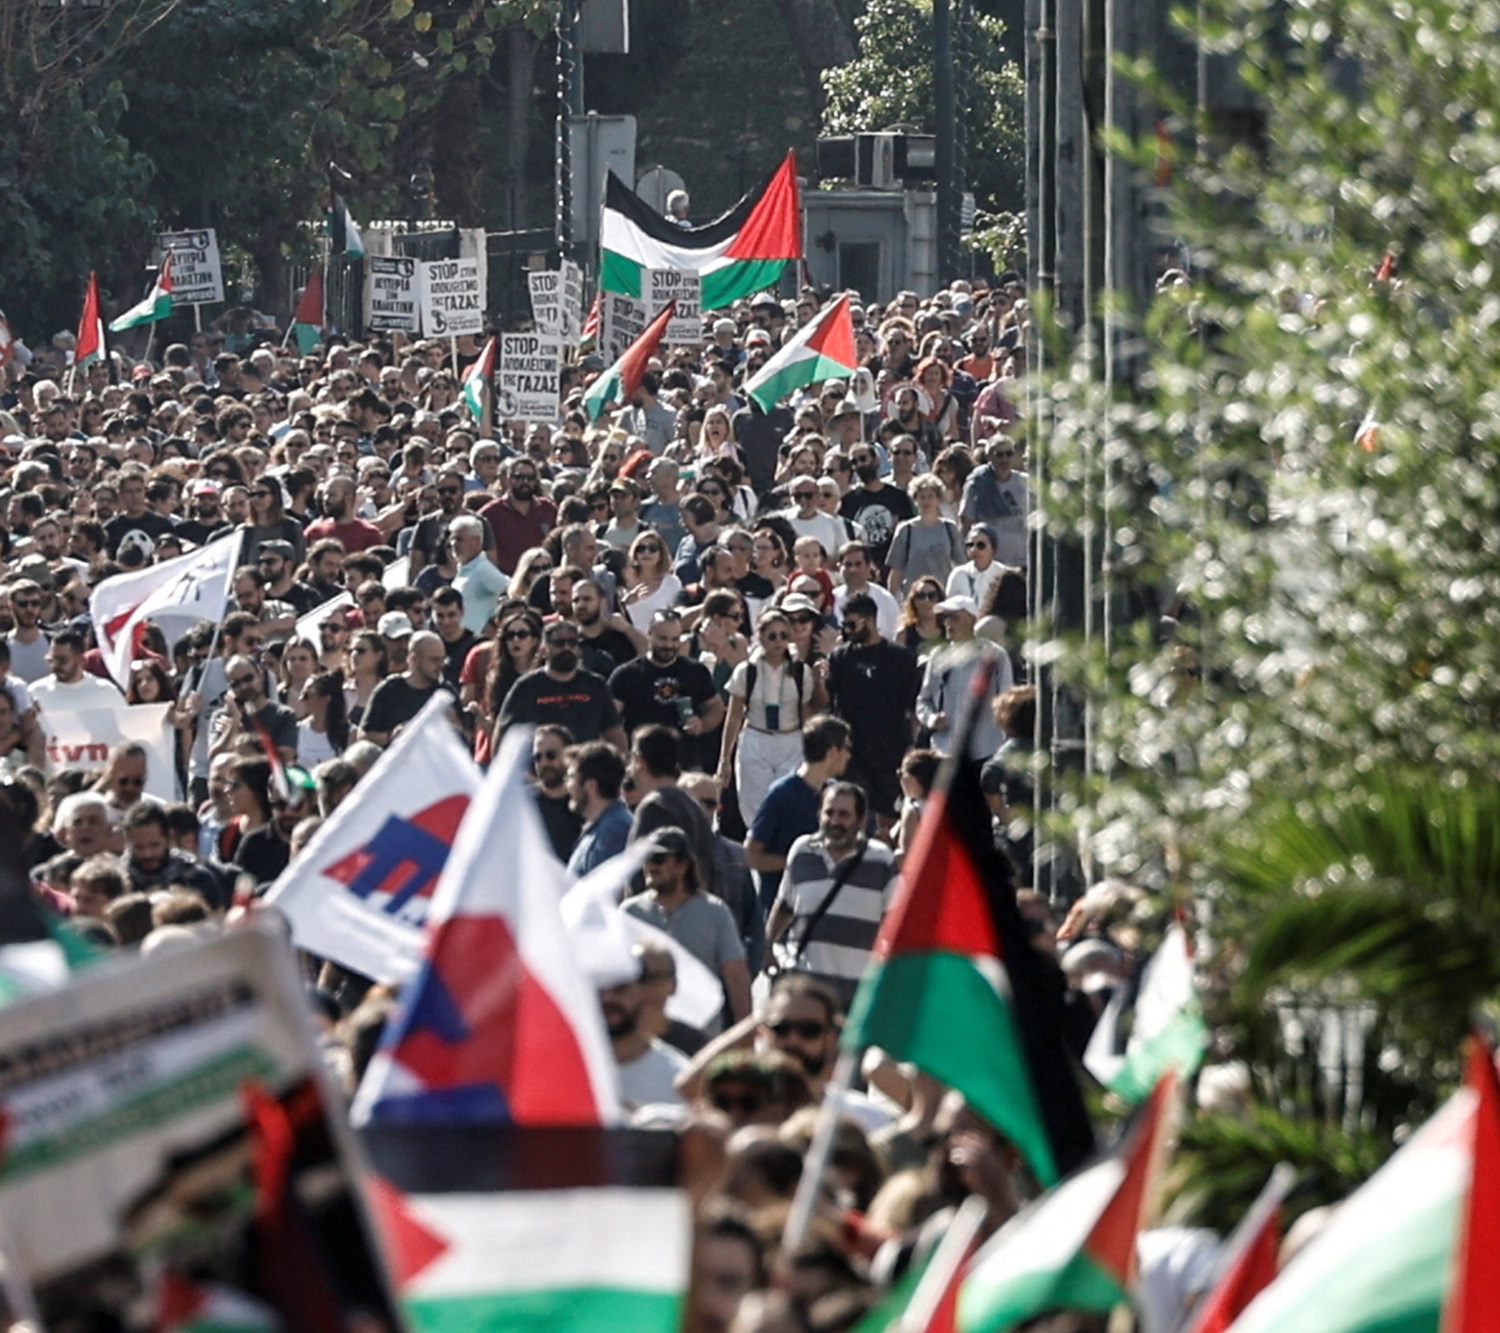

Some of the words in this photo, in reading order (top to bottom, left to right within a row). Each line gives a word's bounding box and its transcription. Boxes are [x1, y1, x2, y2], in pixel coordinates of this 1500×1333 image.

[429, 263, 458, 280] STOP
[652, 271, 682, 287] STOP
[532, 275, 559, 291] STOP
[445, 295, 480, 311] ΓΑΖΑΣ
[505, 337, 538, 355] STOP
[517, 375, 557, 394] ΓΑΖΑΣ
